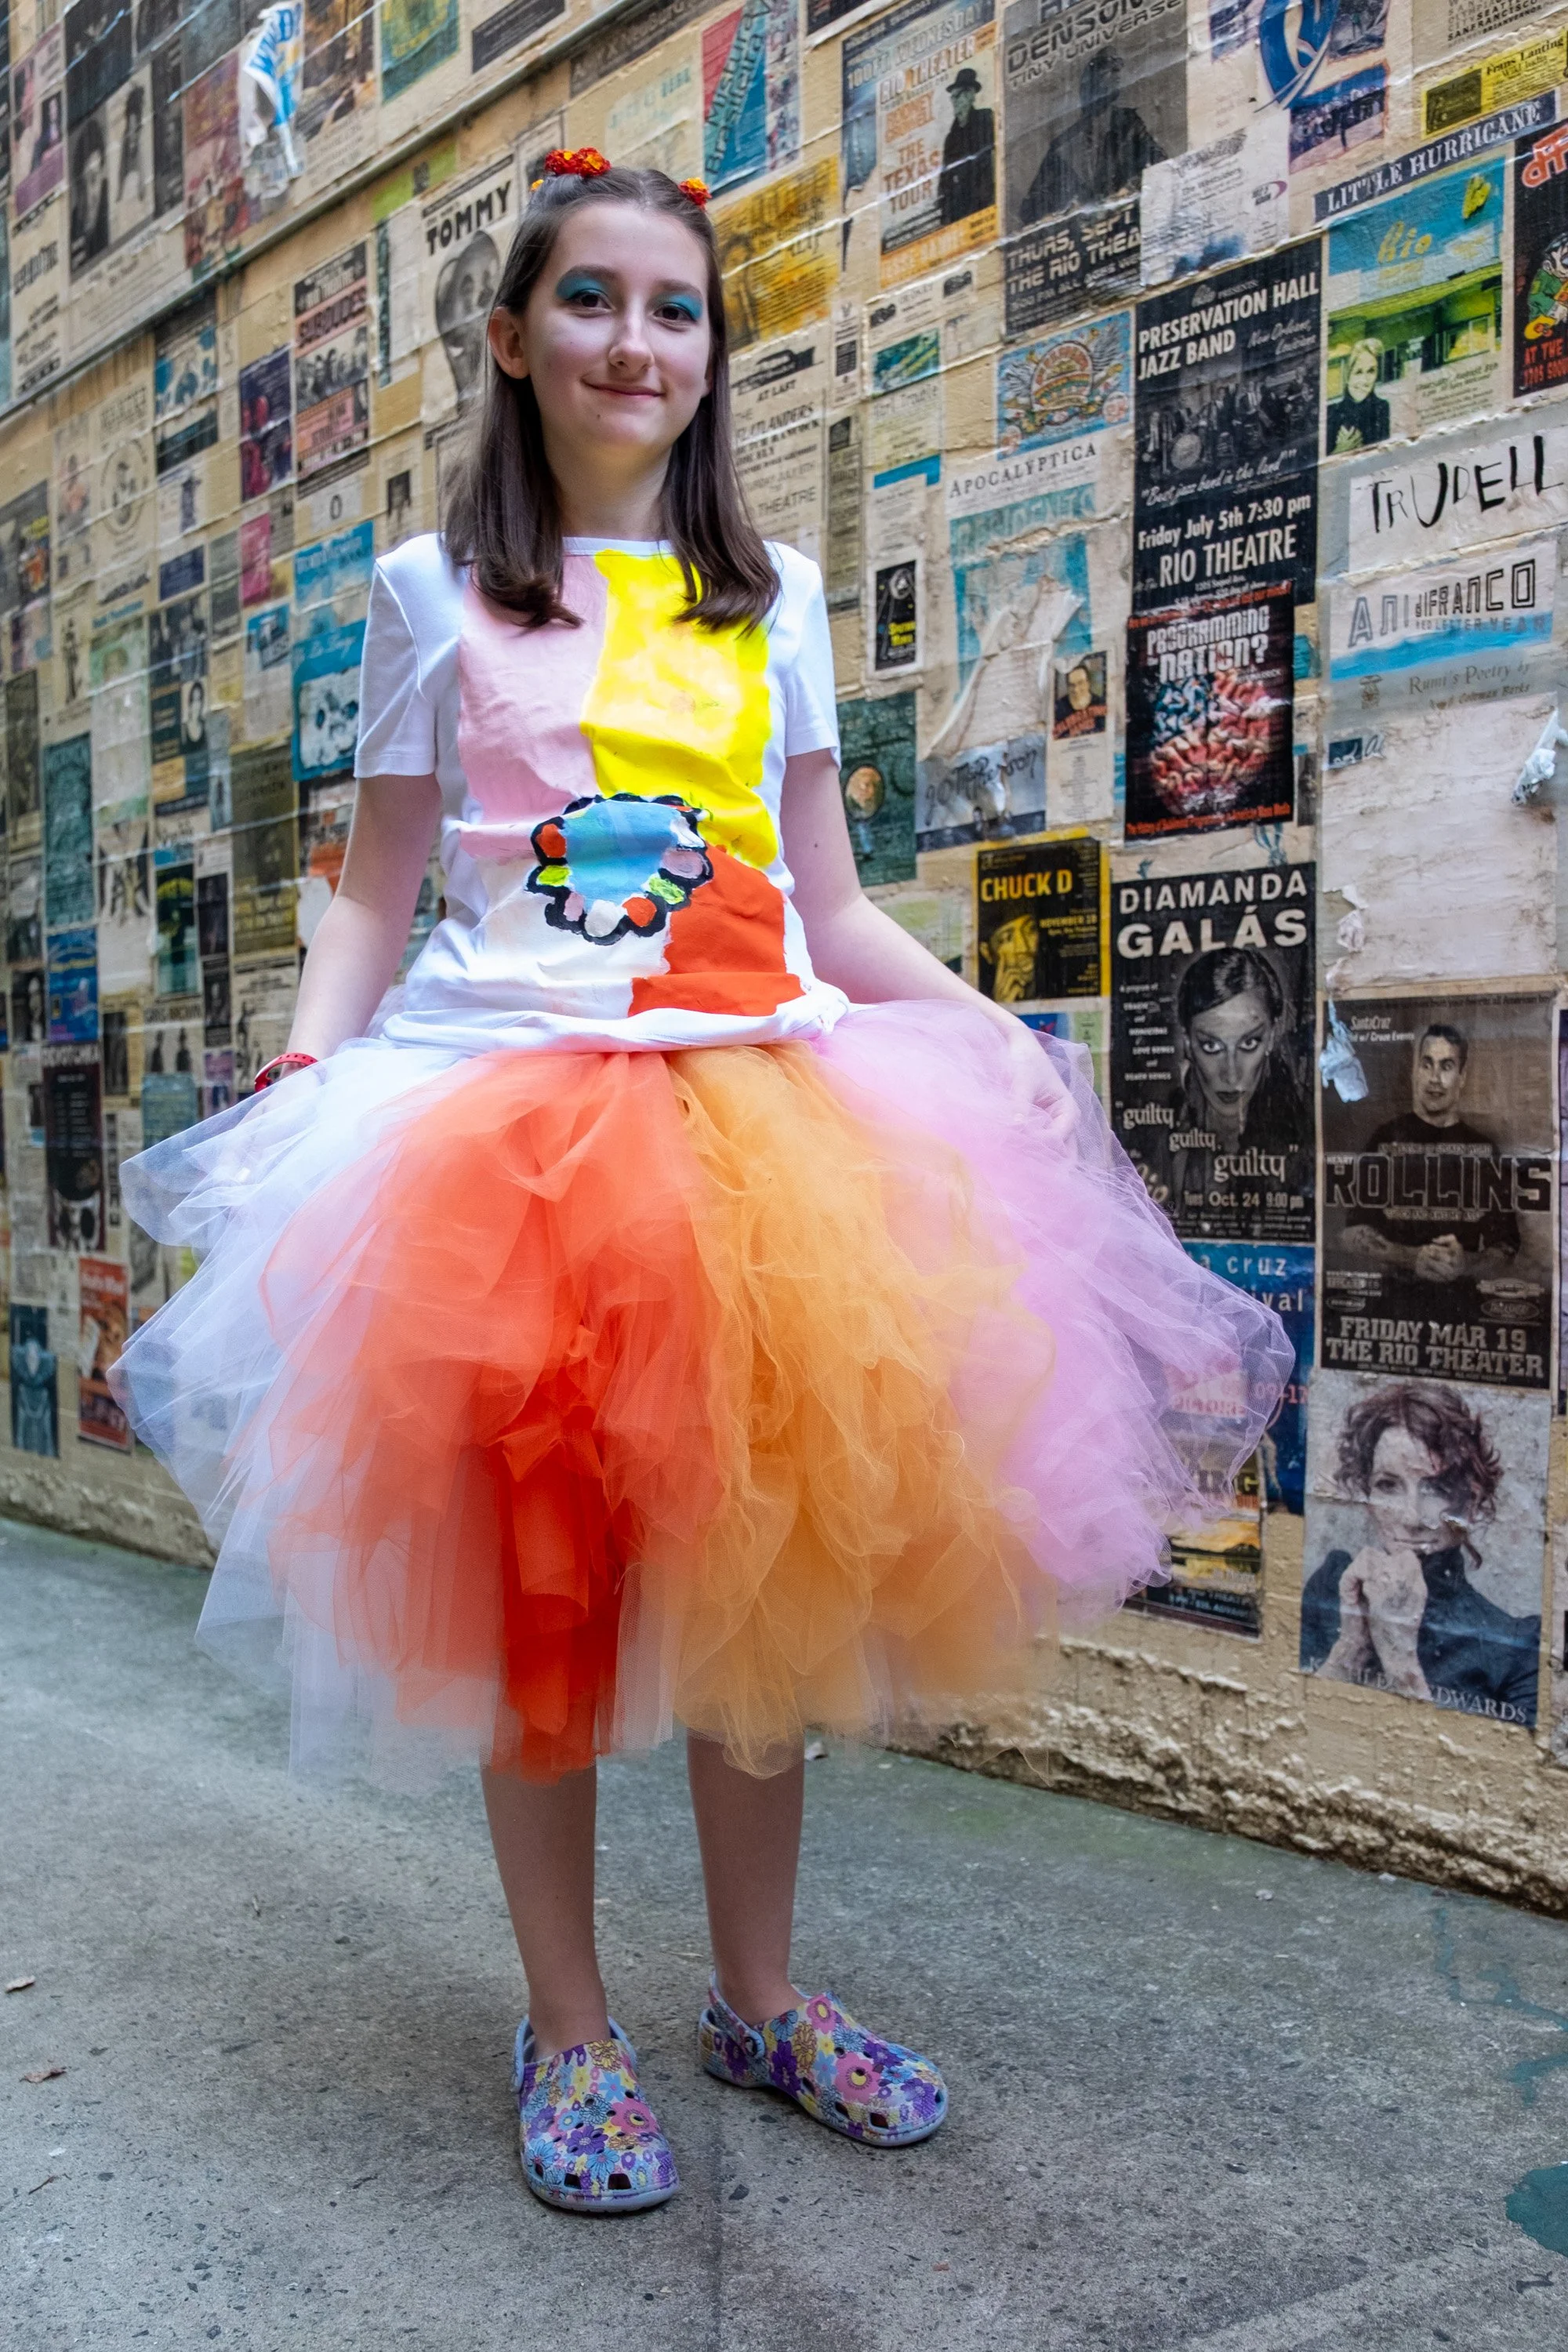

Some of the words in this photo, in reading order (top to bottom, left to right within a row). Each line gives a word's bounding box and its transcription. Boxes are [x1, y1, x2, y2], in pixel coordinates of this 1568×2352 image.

[1327, 163, 1403, 212] LITTLE
[1410, 100, 1541, 176] HURRICANE
[426, 181, 510, 256] TOMMY
[890, 180, 932, 214] TOUR
[1008, 266, 1044, 295] THE
[1049, 252, 1080, 280] RIO
[1086, 227, 1141, 264] THEA
[1139, 288, 1268, 353] PRESERVATION
[1272, 272, 1319, 308] HALL
[1138, 347, 1181, 381] JAZZ
[1186, 328, 1236, 365] BAND
[949, 443, 1096, 499] APOCALYPTICA
[1369, 435, 1564, 533] TRUDELL
[1138, 524, 1181, 551] Friday
[1184, 514, 1214, 540] July
[1218, 506, 1243, 532] 5th
[1247, 495, 1283, 524] 7:30
[1287, 494, 1312, 519] pm
[1160, 549, 1196, 588] RIO
[1202, 524, 1298, 578] THEATRE
[981, 871, 1051, 902] CHUCK
[1056, 869, 1073, 894] D
[1120, 869, 1307, 915] DIAMANDA
[1117, 905, 1308, 960] GALÁS
[1152, 1045, 1174, 1054] SONGS
[1242, 1192, 1261, 1207] 24
[1326, 1152, 1551, 1214] ROLLINS
[1226, 1254, 1287, 1277] cruz
[1326, 1338, 1372, 1362] THE
[1378, 1341, 1419, 1367] RIO
[1425, 1345, 1544, 1378] THEATER
[1340, 1316, 1423, 1344] FRIDAY
[1428, 1320, 1486, 1350] MAR
[1496, 1327, 1527, 1352] 19
[1432, 1684, 1527, 1725] DWARDS
